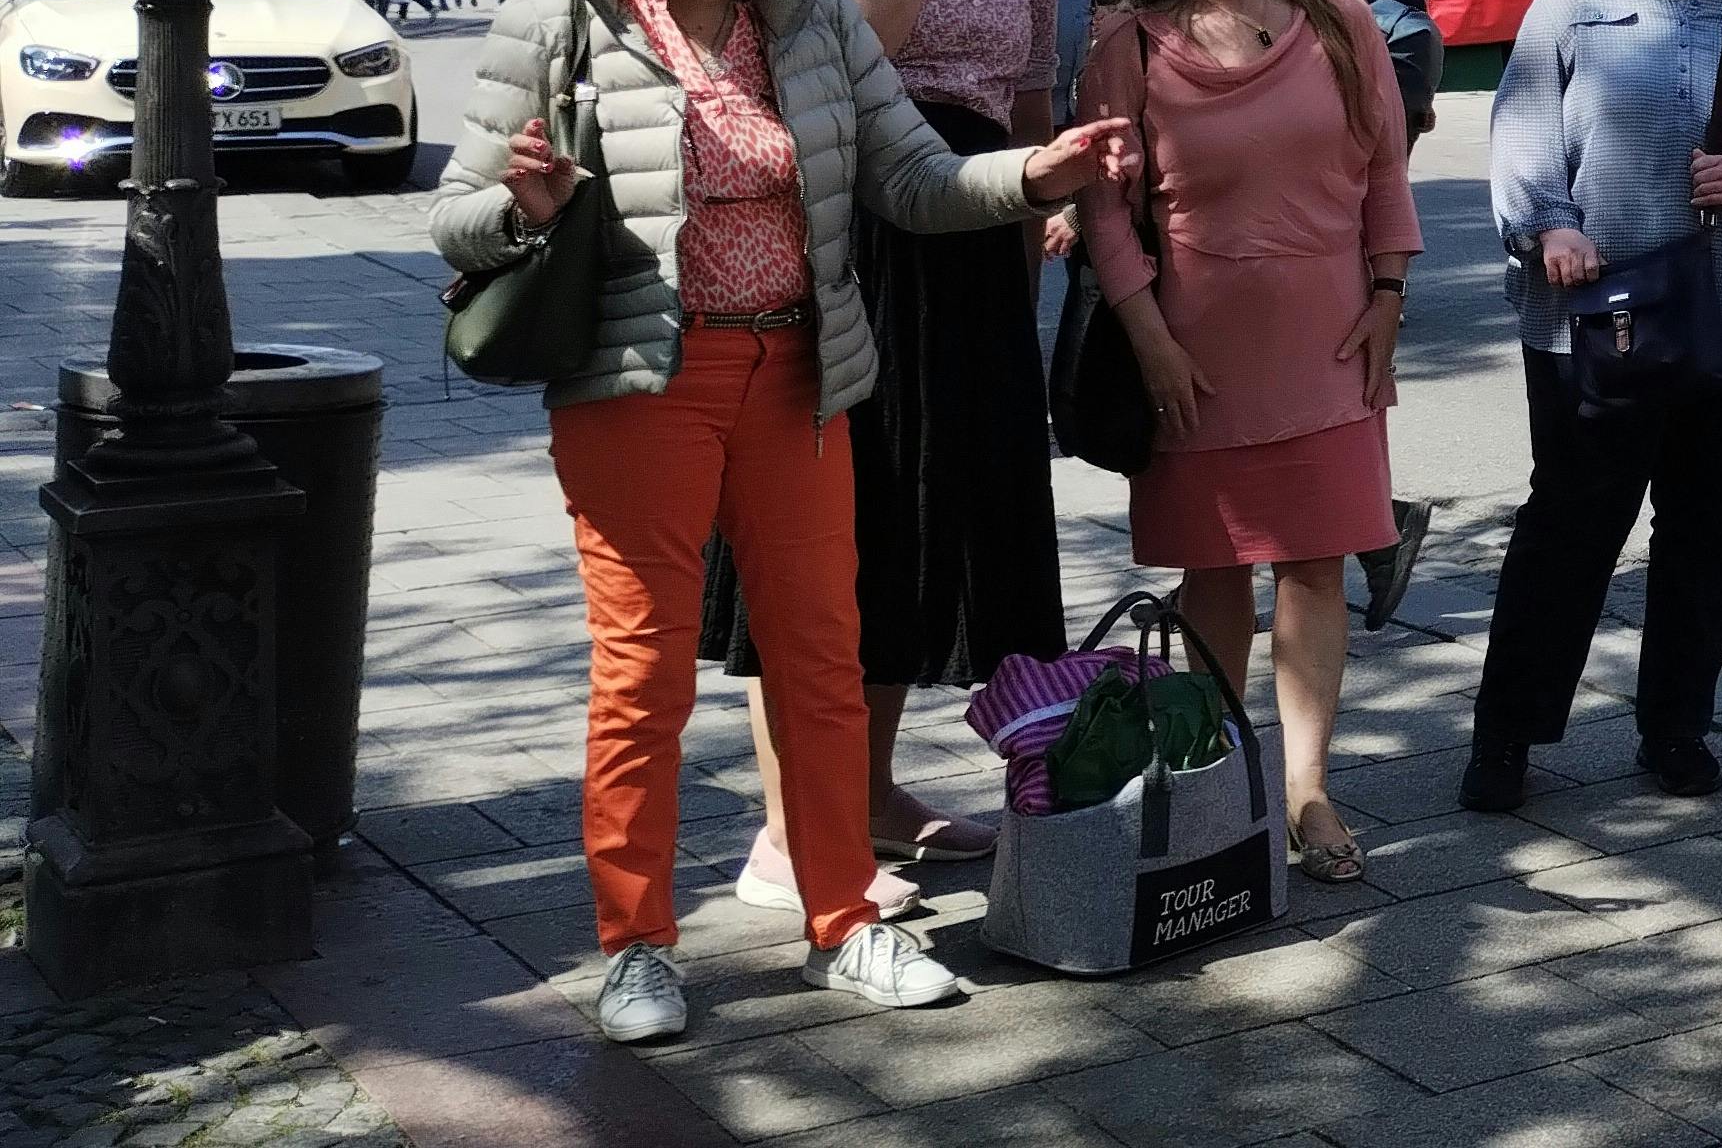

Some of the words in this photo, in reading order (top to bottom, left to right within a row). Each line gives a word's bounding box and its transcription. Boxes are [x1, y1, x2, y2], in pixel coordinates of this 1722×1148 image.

[238, 110, 271, 127] 651
[1161, 879, 1215, 916] TOUR
[1153, 890, 1251, 946] MANAGER
